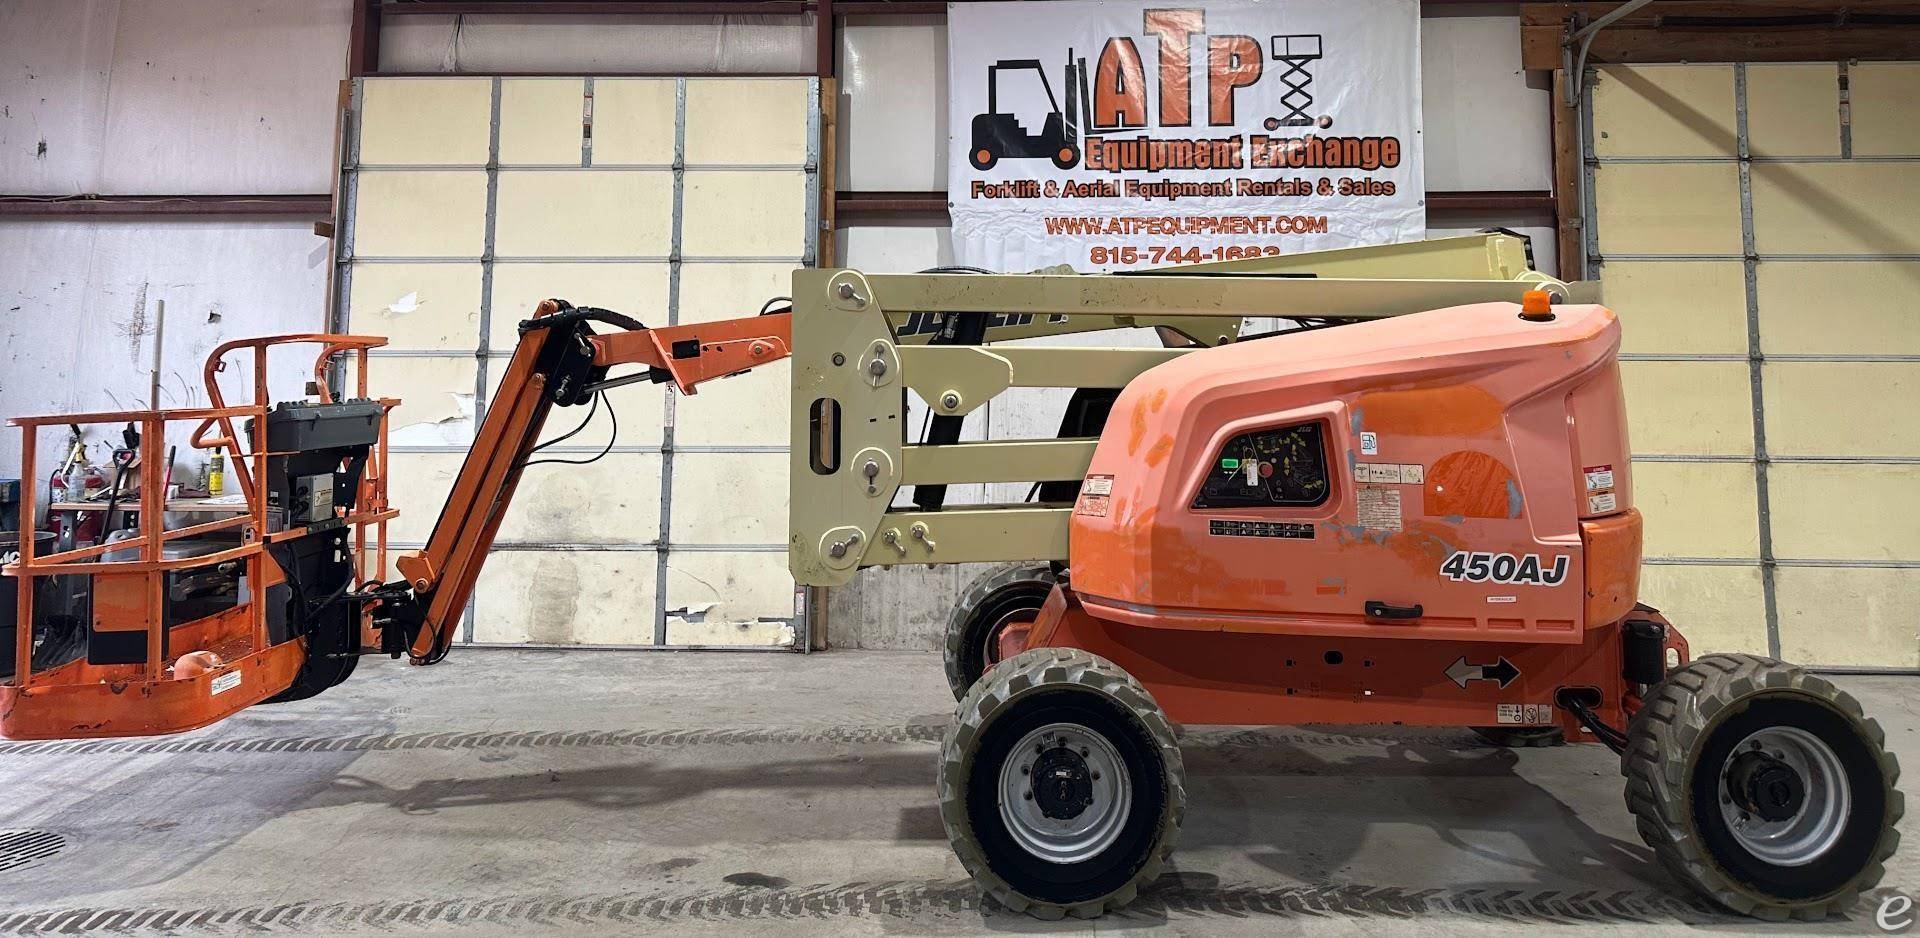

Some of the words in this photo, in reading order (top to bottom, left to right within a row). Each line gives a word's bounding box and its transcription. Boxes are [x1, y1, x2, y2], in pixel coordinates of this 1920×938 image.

[1093, 8, 1264, 128] ATP
[1085, 136, 1243, 173] Equipment
[1251, 134, 1400, 171] Exchange
[971, 180, 1040, 198] Forklift
[1043, 180, 1060, 198] &
[1062, 180, 1120, 198] Aerial
[1124, 179, 1232, 200] Equipment
[1236, 177, 1312, 197] Rentals
[1316, 178, 1335, 197] &
[1338, 177, 1396, 197] Sales
[1045, 216, 1328, 236] WWW.ATPEQUIPMENT.COM
[1440, 551, 1570, 587] 450AJ
